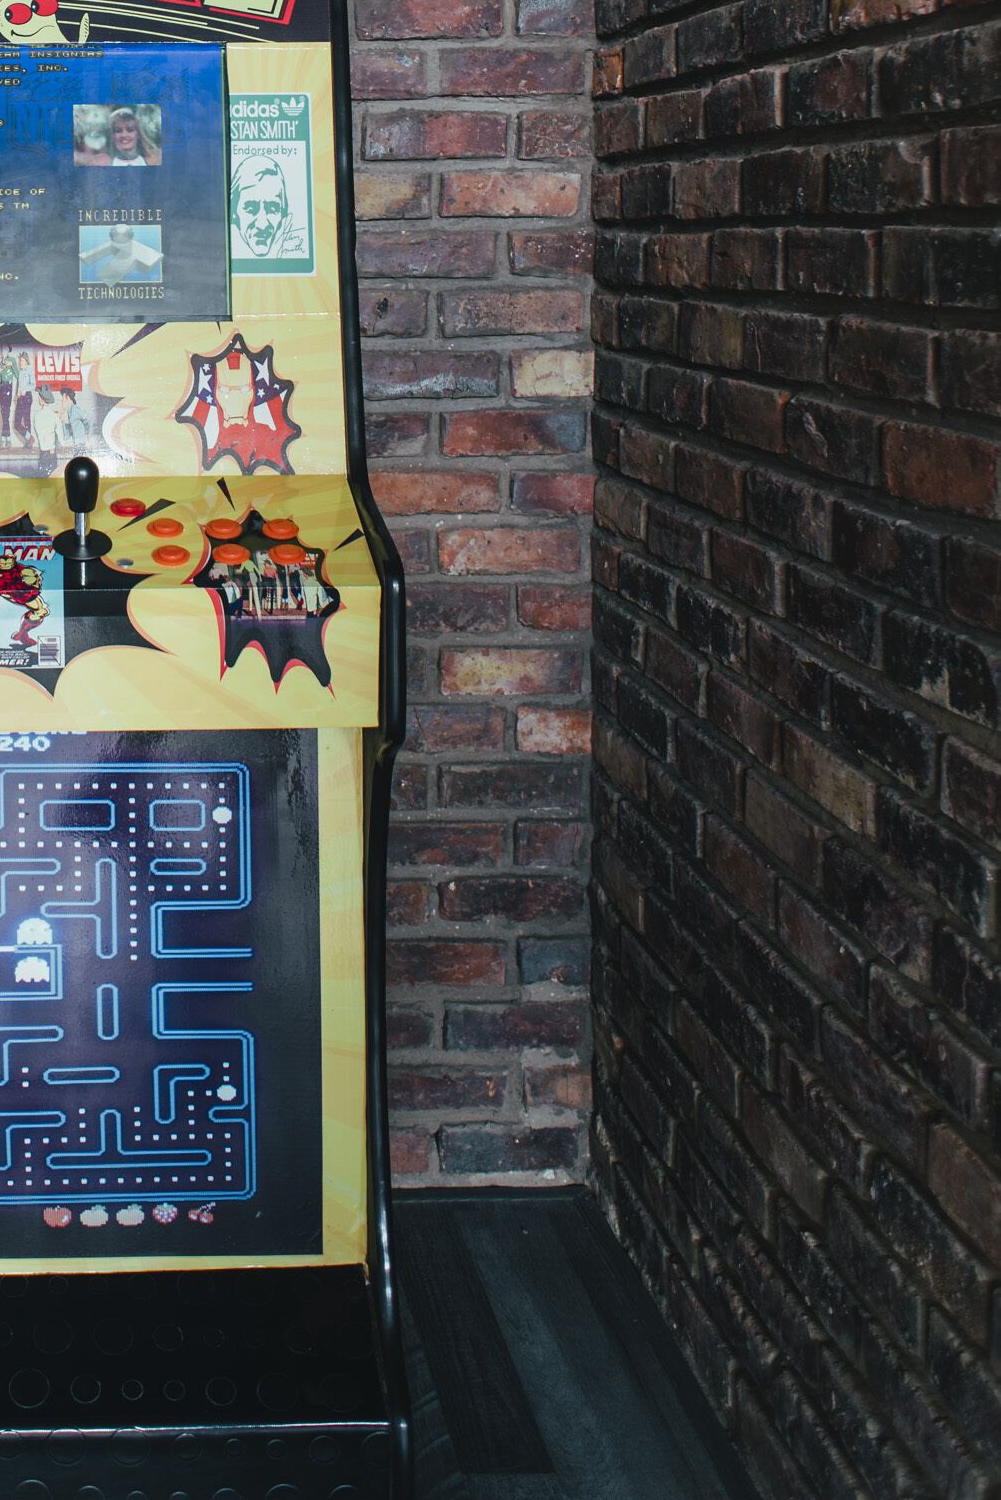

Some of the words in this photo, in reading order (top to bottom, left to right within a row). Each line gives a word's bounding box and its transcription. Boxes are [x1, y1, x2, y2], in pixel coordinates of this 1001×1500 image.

[230, 121, 258, 139] STAN
[232, 145, 279, 156] Endorsed
[29, 188, 46, 196] OF
[13, 202, 30, 210] TM
[78, 209, 162, 222] INCREDIBLE
[78, 286, 165, 300] TECHNOLOGIES
[37, 350, 80, 373] LEVIS
[3, 546, 56, 562] MAN
